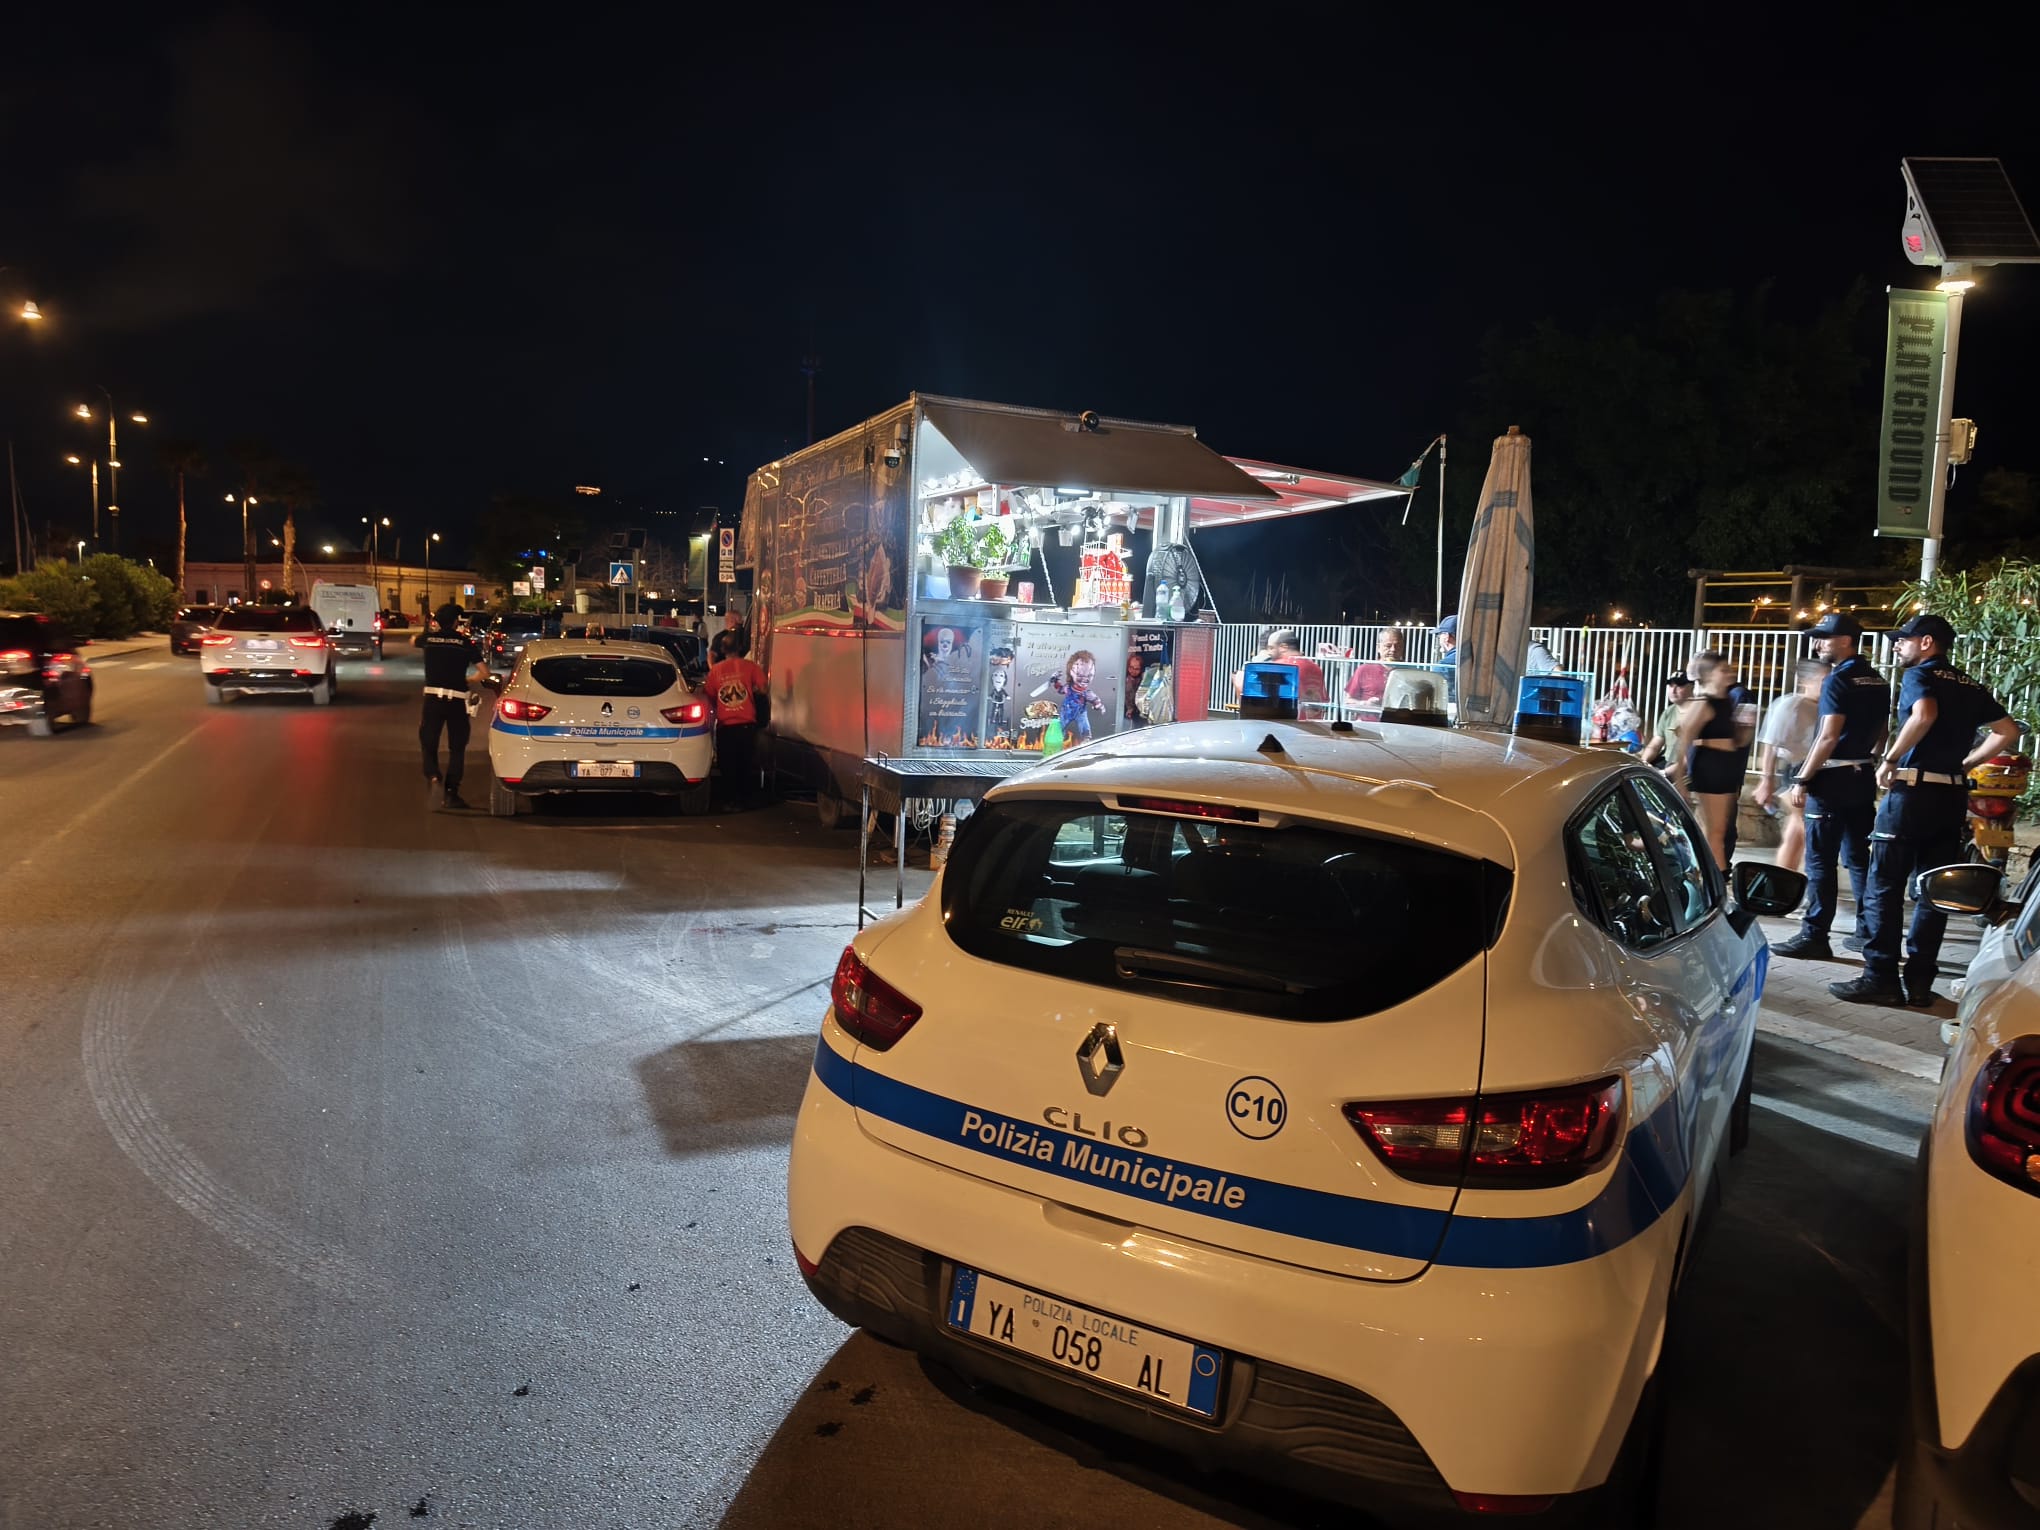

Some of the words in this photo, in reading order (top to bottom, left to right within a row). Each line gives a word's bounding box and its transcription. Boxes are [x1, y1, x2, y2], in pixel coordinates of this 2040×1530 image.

[1888, 314, 1935, 503] PLAYGROUND
[569, 727, 597, 735] Polizia
[599, 728, 644, 736] Municipale
[1000, 916, 1029, 929] elf
[1043, 1105, 1149, 1148] CLIO
[1229, 1090, 1283, 1126] C10
[960, 1111, 1053, 1162] Polizia
[1061, 1139, 1246, 1210] Municipale
[1023, 1294, 1073, 1324] POLIZIA
[1082, 1314, 1139, 1346] LOCALE
[989, 1301, 1015, 1343] YA
[1052, 1330, 1103, 1372] 058
[1137, 1353, 1171, 1398] AL
